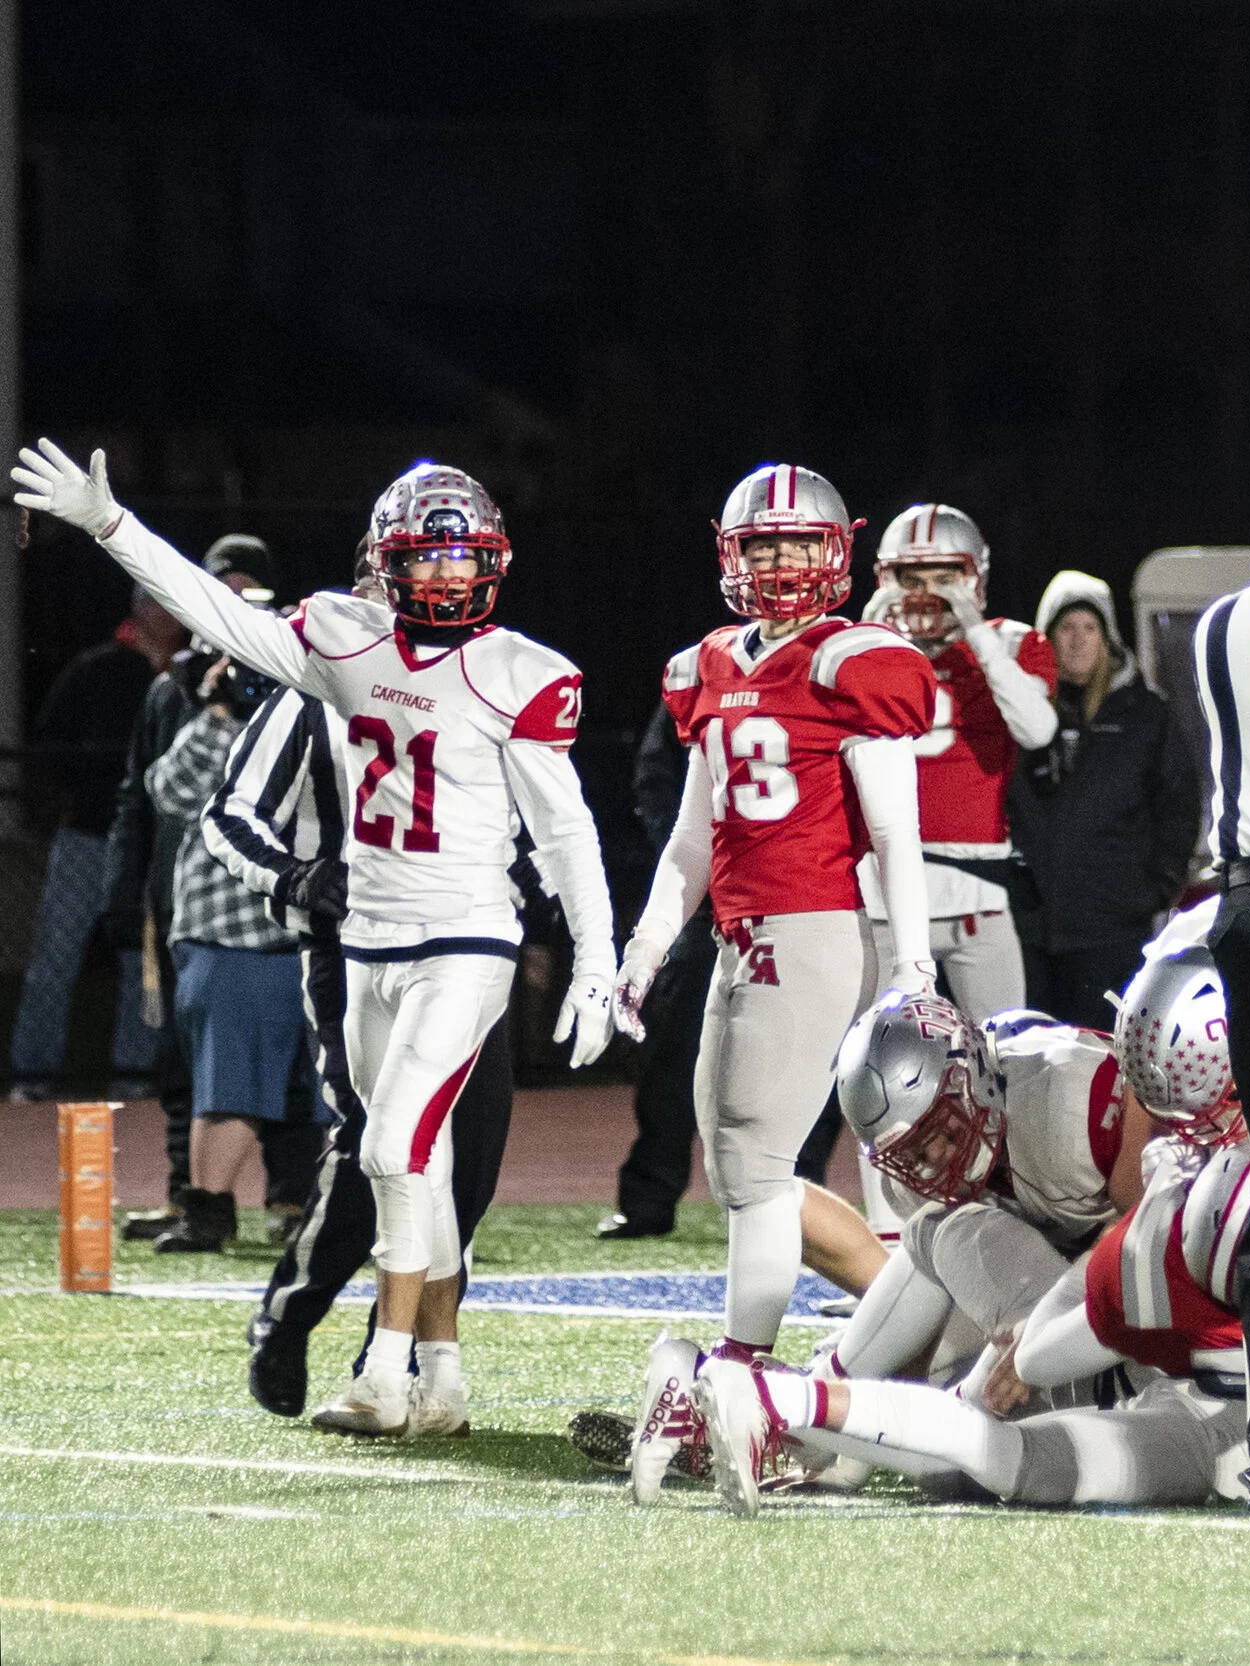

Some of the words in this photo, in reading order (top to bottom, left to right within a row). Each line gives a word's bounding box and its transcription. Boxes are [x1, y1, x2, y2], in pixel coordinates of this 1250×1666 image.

[371, 683, 438, 713] CARTHAGE
[555, 686, 583, 729] 21
[348, 713, 440, 853] 21
[705, 716, 801, 821] 13
[639, 1375, 681, 1445] adidas
